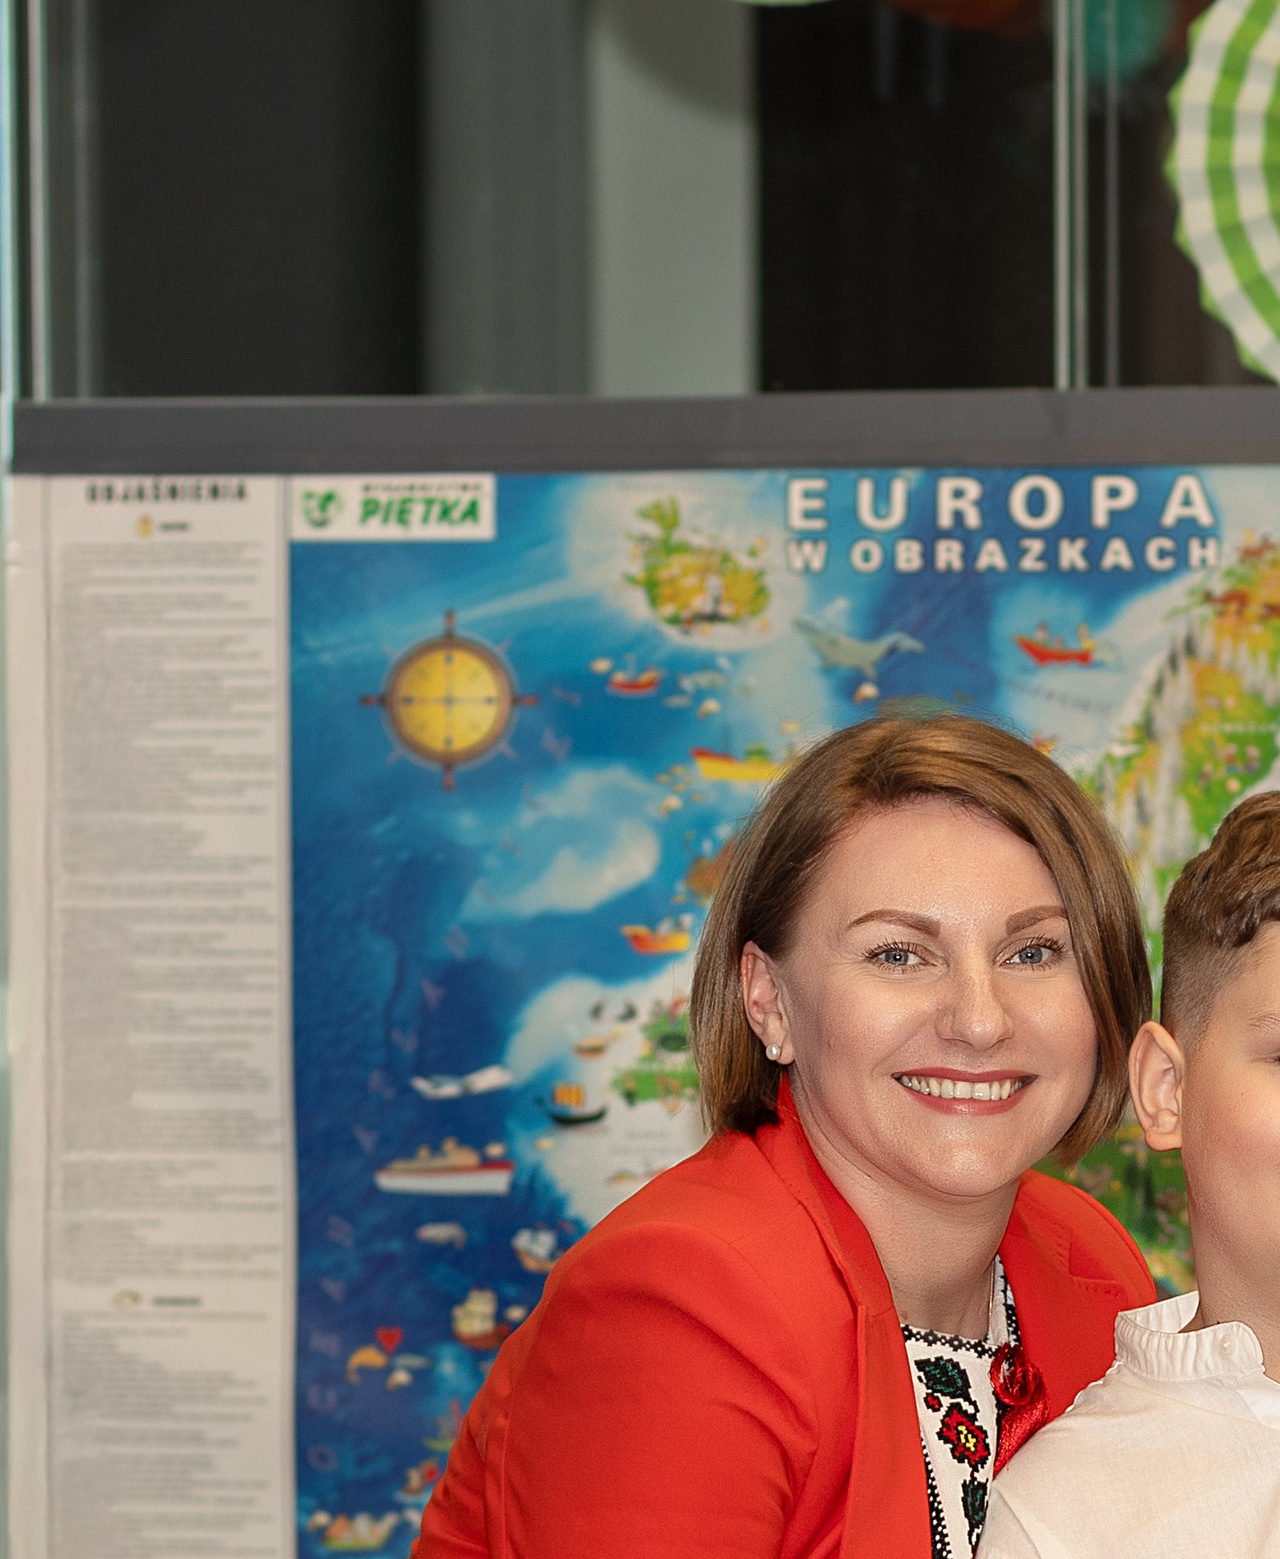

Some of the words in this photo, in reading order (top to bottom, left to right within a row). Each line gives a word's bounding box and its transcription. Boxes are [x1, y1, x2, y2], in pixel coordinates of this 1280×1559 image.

[359, 497, 481, 529] PIĘTKA
[787, 475, 1216, 531] EUROPA
[788, 537, 828, 573] W
[850, 536, 1220, 573] OBRAZKACH
